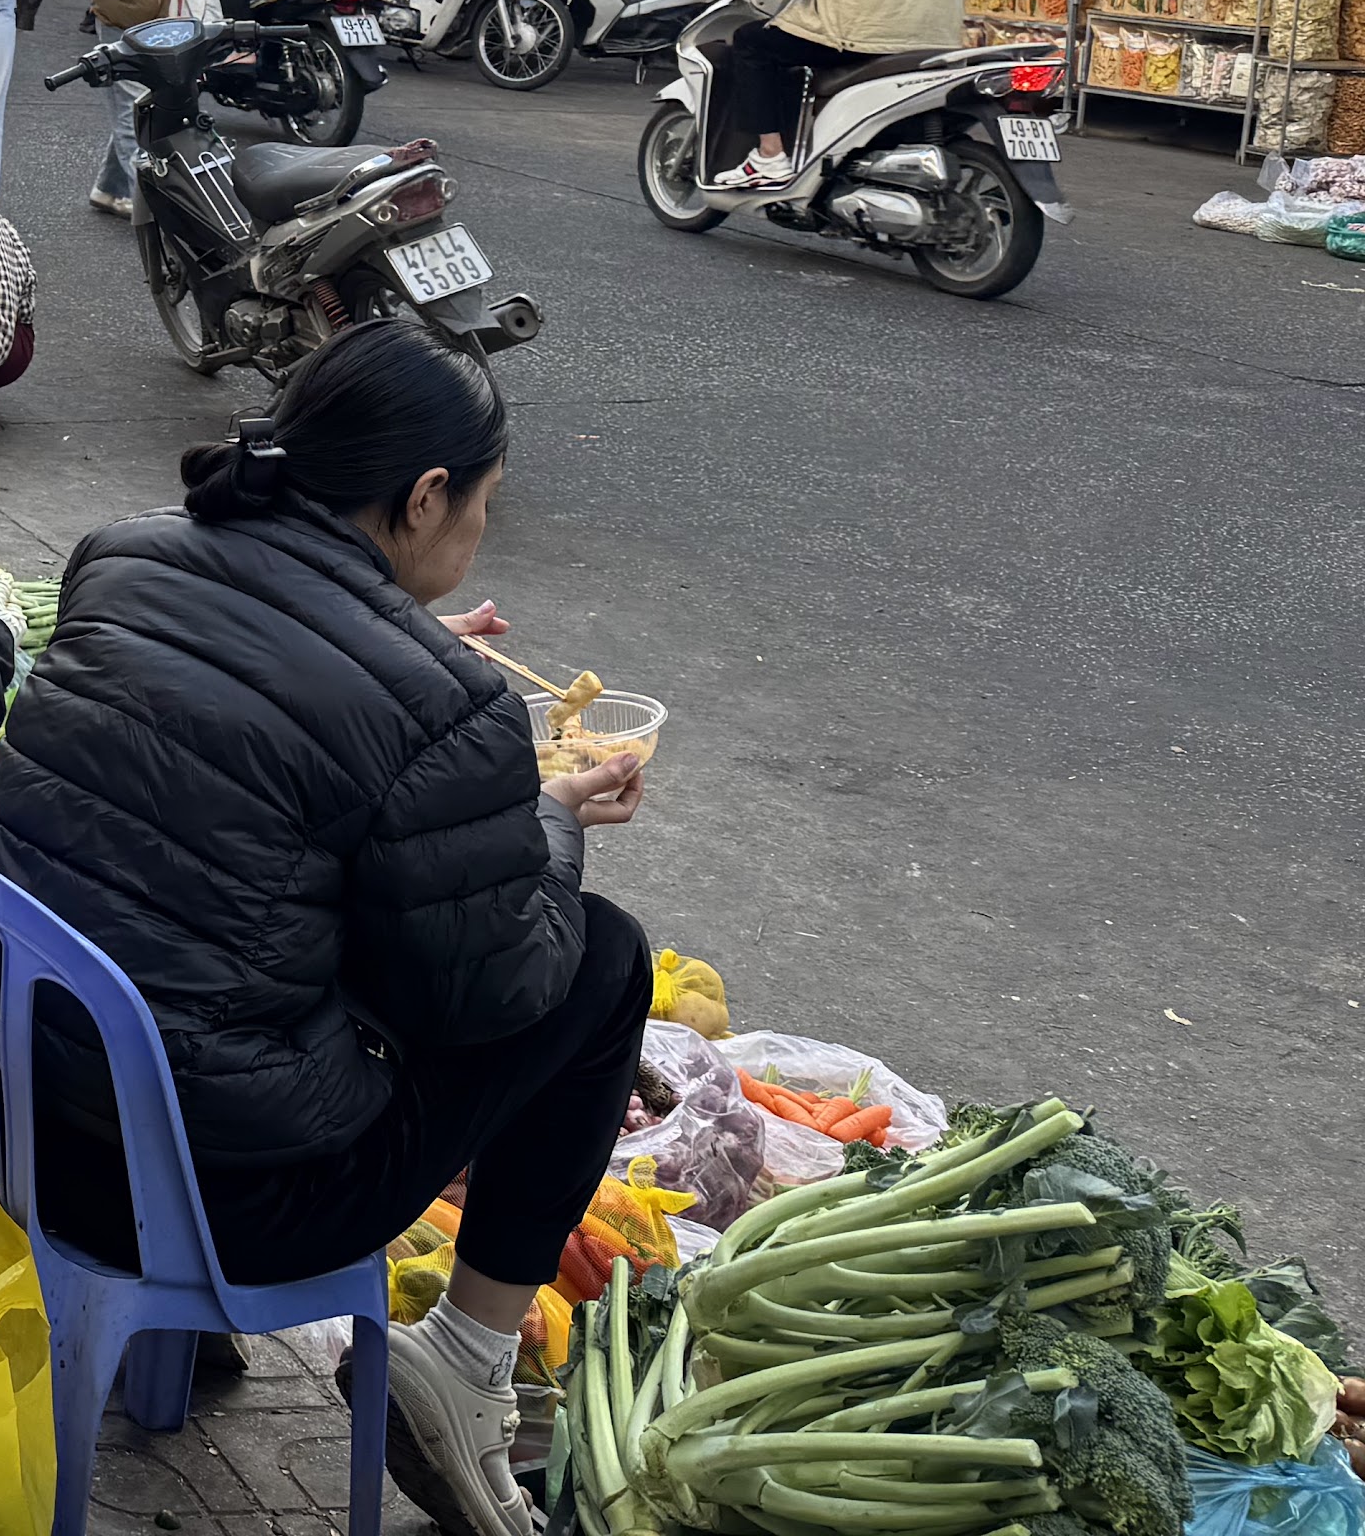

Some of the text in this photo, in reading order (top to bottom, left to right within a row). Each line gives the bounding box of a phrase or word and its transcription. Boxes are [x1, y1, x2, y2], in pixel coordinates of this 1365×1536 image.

[341, 17, 372, 32] 49-P3
[344, 30, 380, 45] 7714
[1010, 120, 1048, 140] 49-B1
[1008, 139, 1059, 160] 700.11
[401, 231, 466, 271] 47-L4
[416, 256, 482, 296] 5589
